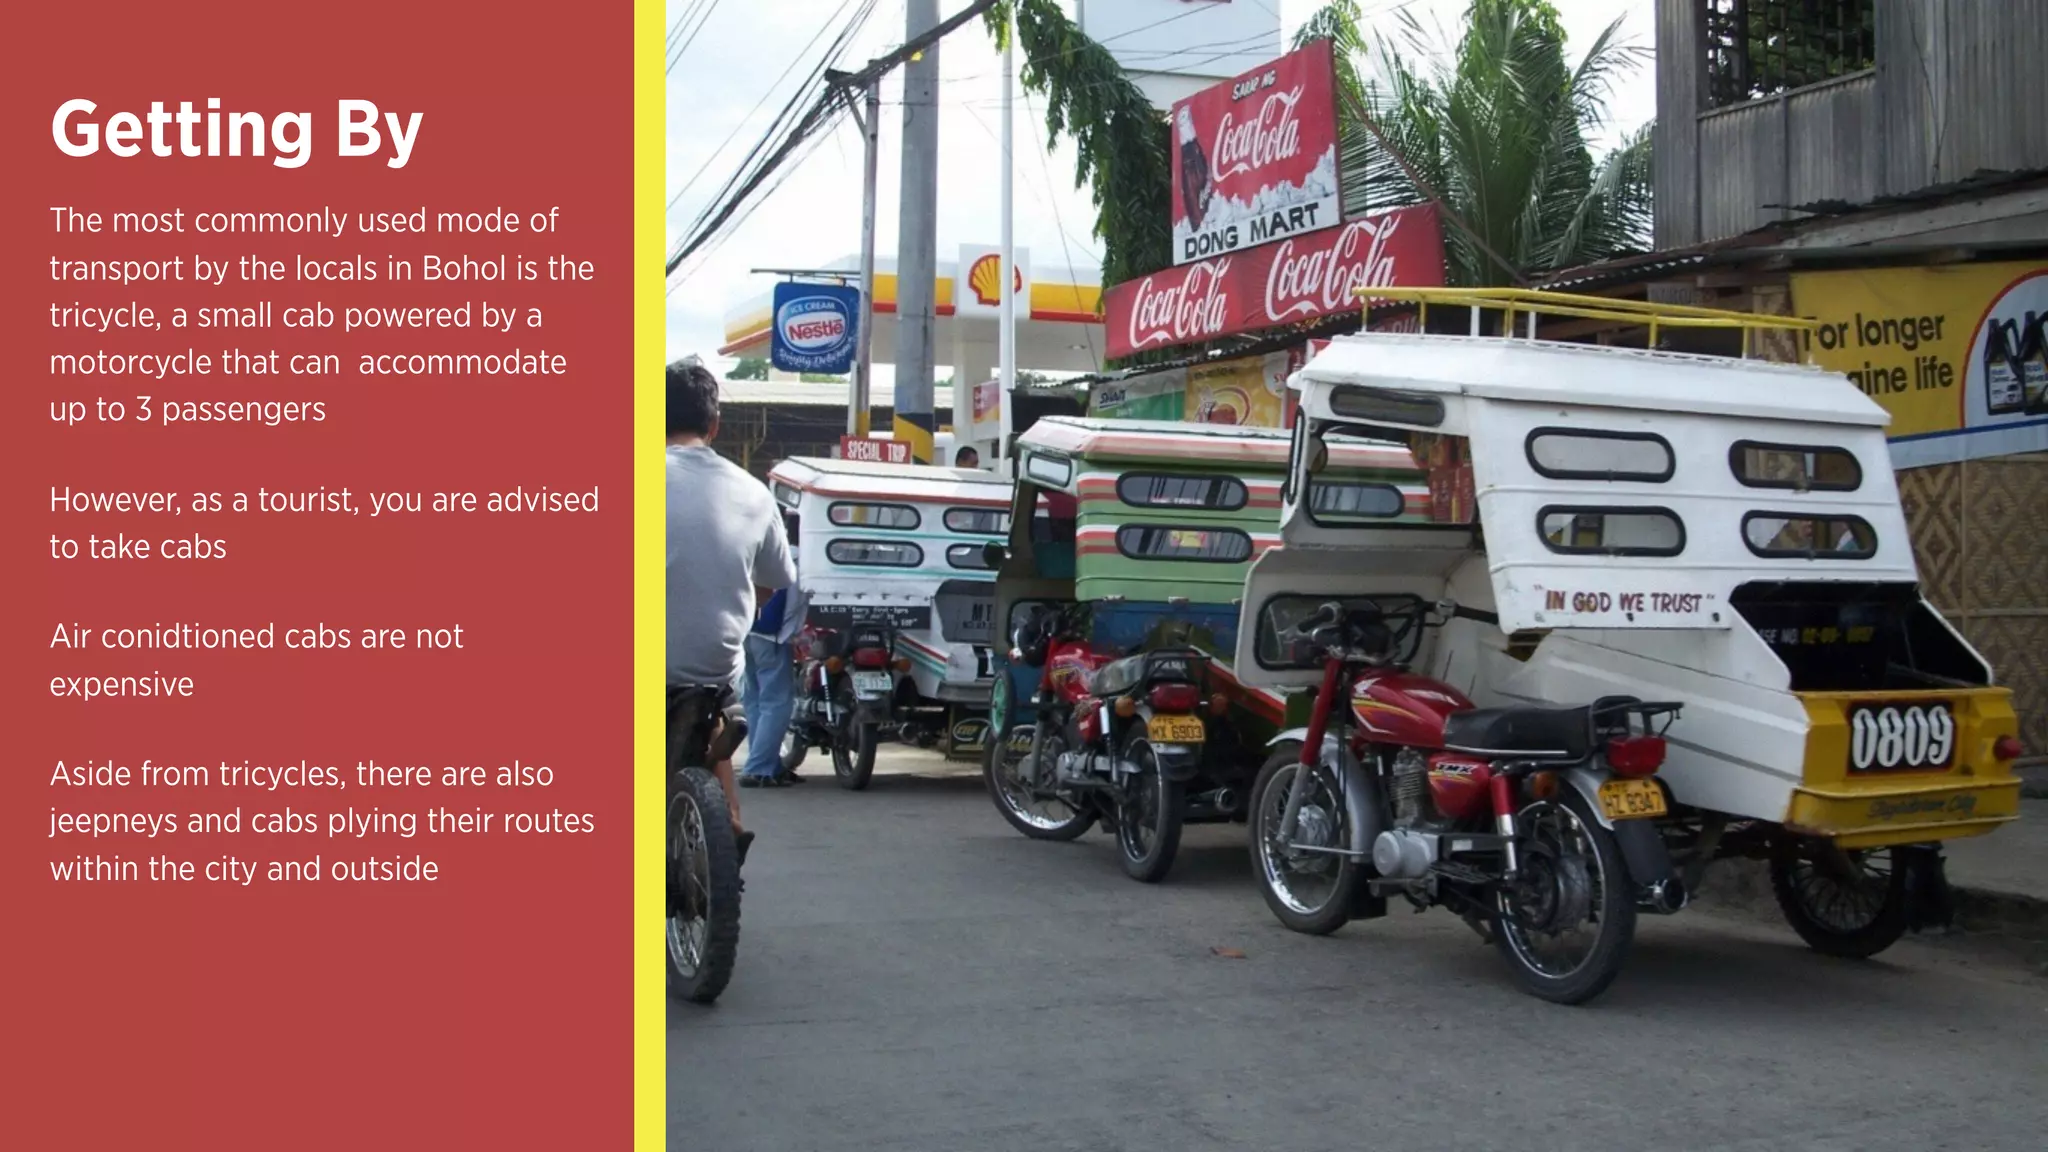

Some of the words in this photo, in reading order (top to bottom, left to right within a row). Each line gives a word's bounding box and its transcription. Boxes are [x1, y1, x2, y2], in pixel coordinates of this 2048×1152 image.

[1184, 225, 1239, 260] DONG
[1250, 203, 1319, 243] MART
[790, 304, 804, 313] ICE
[804, 301, 836, 312] CREAM
[1855, 312, 1945, 352] longer
[1913, 355, 1954, 390] life
[847, 440, 882, 461] SPECIAL
[886, 443, 907, 462] TRIP
[1573, 591, 1612, 613] GOD
[1619, 591, 1645, 613] WE
[1171, 724, 1203, 739] 6903
[1852, 705, 1954, 769] 0809
[1436, 762, 1477, 774] TMX
[1603, 793, 1625, 814] HZ
